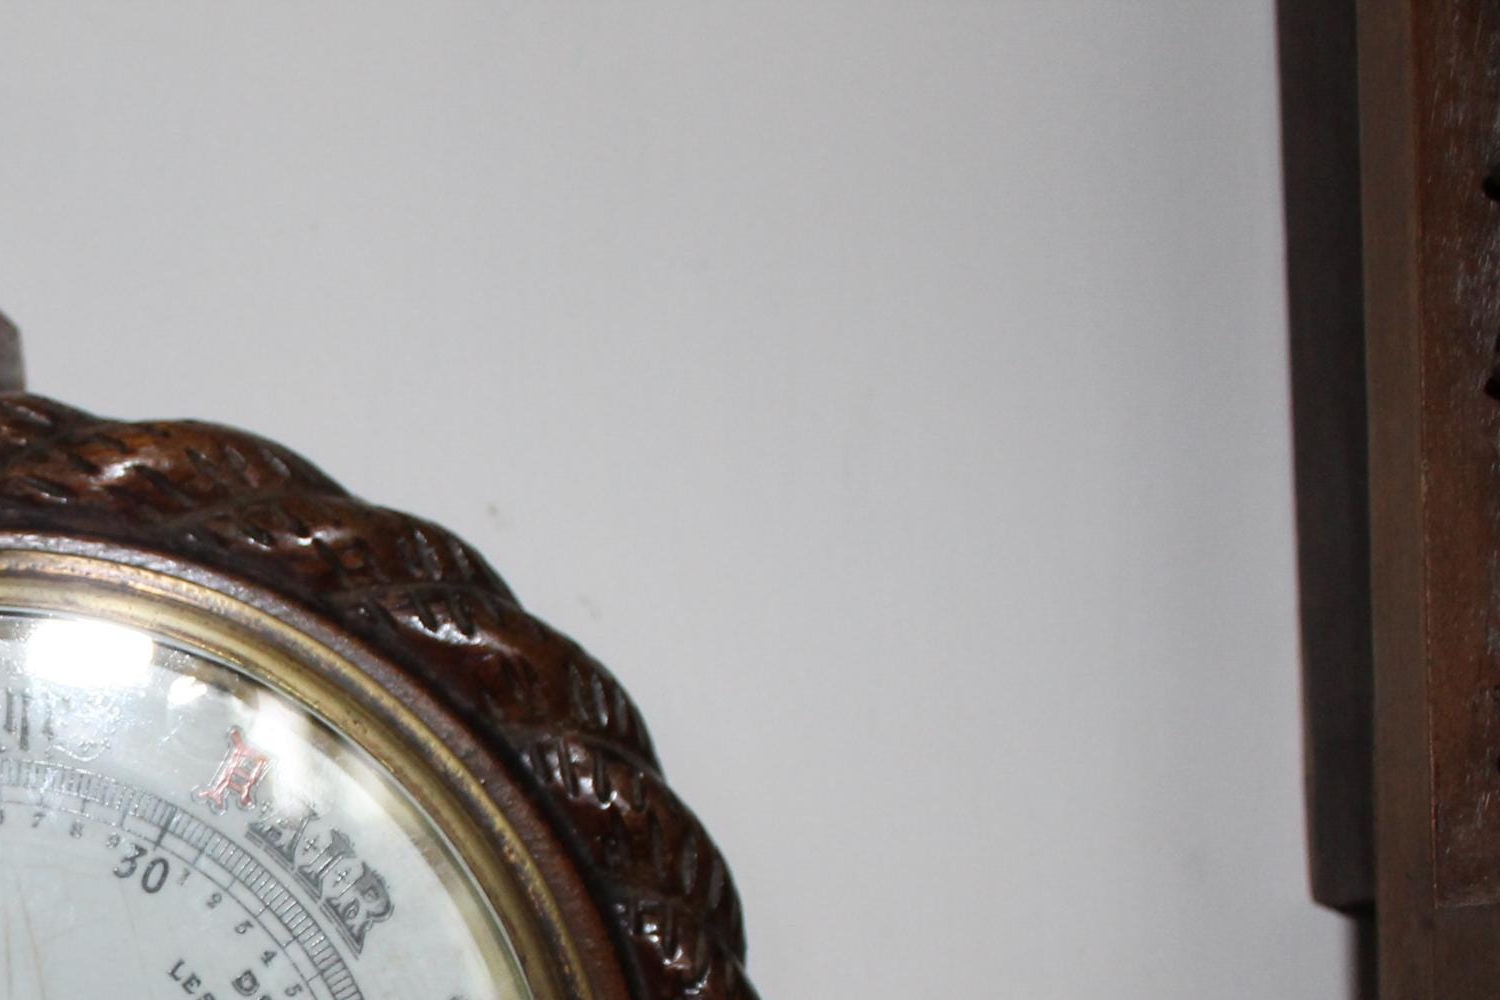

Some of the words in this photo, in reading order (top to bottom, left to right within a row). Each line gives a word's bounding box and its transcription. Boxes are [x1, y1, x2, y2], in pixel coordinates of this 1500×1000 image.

[32, 812, 45, 829] 7
[70, 819, 83, 838] 8
[106, 833, 120, 848] 9
[112, 848, 170, 895] 30
[177, 868, 190, 885] 1
[207, 893, 222, 909] 2
[234, 921, 250, 935] 3
[260, 951, 274, 967] 4
[285, 984, 302, 998] 5
